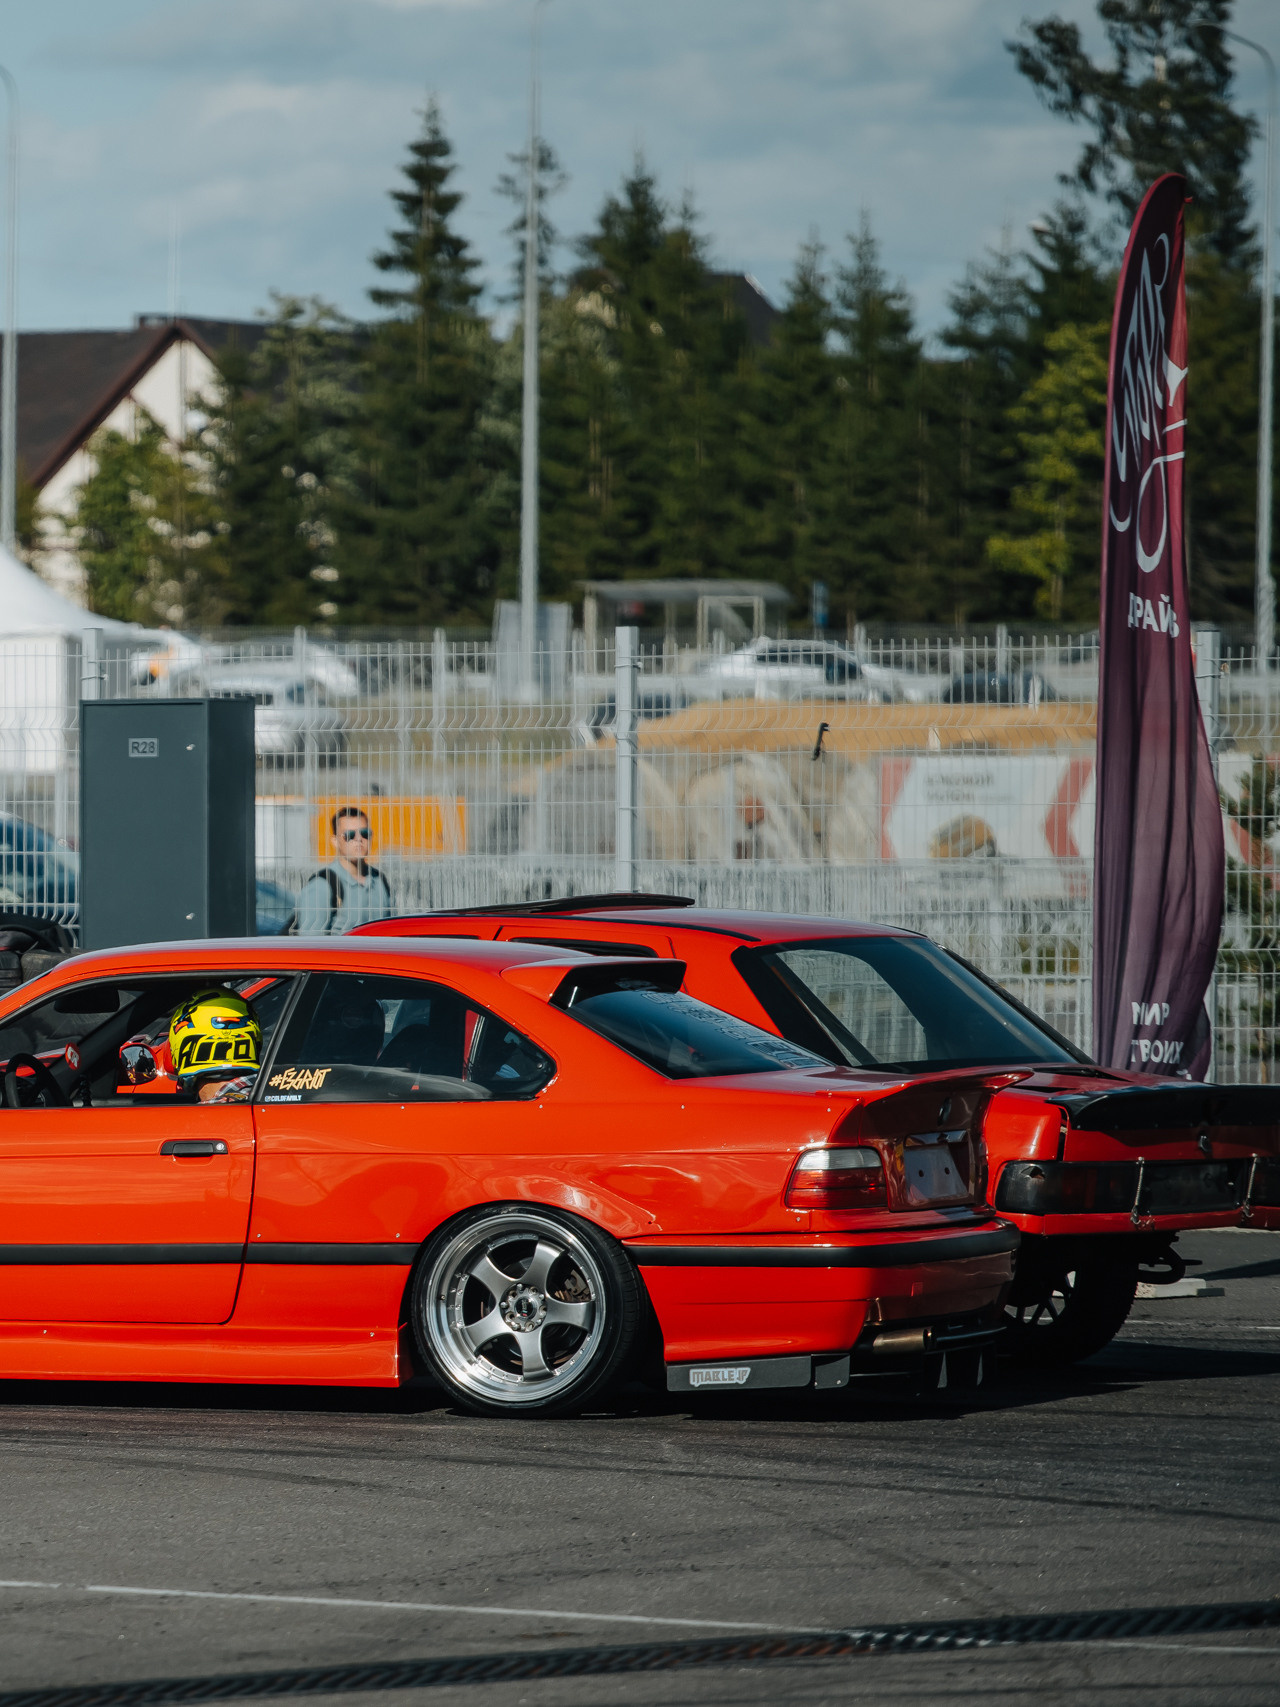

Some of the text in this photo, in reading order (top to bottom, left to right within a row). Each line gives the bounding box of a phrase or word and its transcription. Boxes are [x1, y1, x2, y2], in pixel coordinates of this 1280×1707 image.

[131, 741, 156, 754] R28
[1131, 1001, 1170, 1026] МИР
[1131, 1039, 1185, 1064] ТВОИХ
